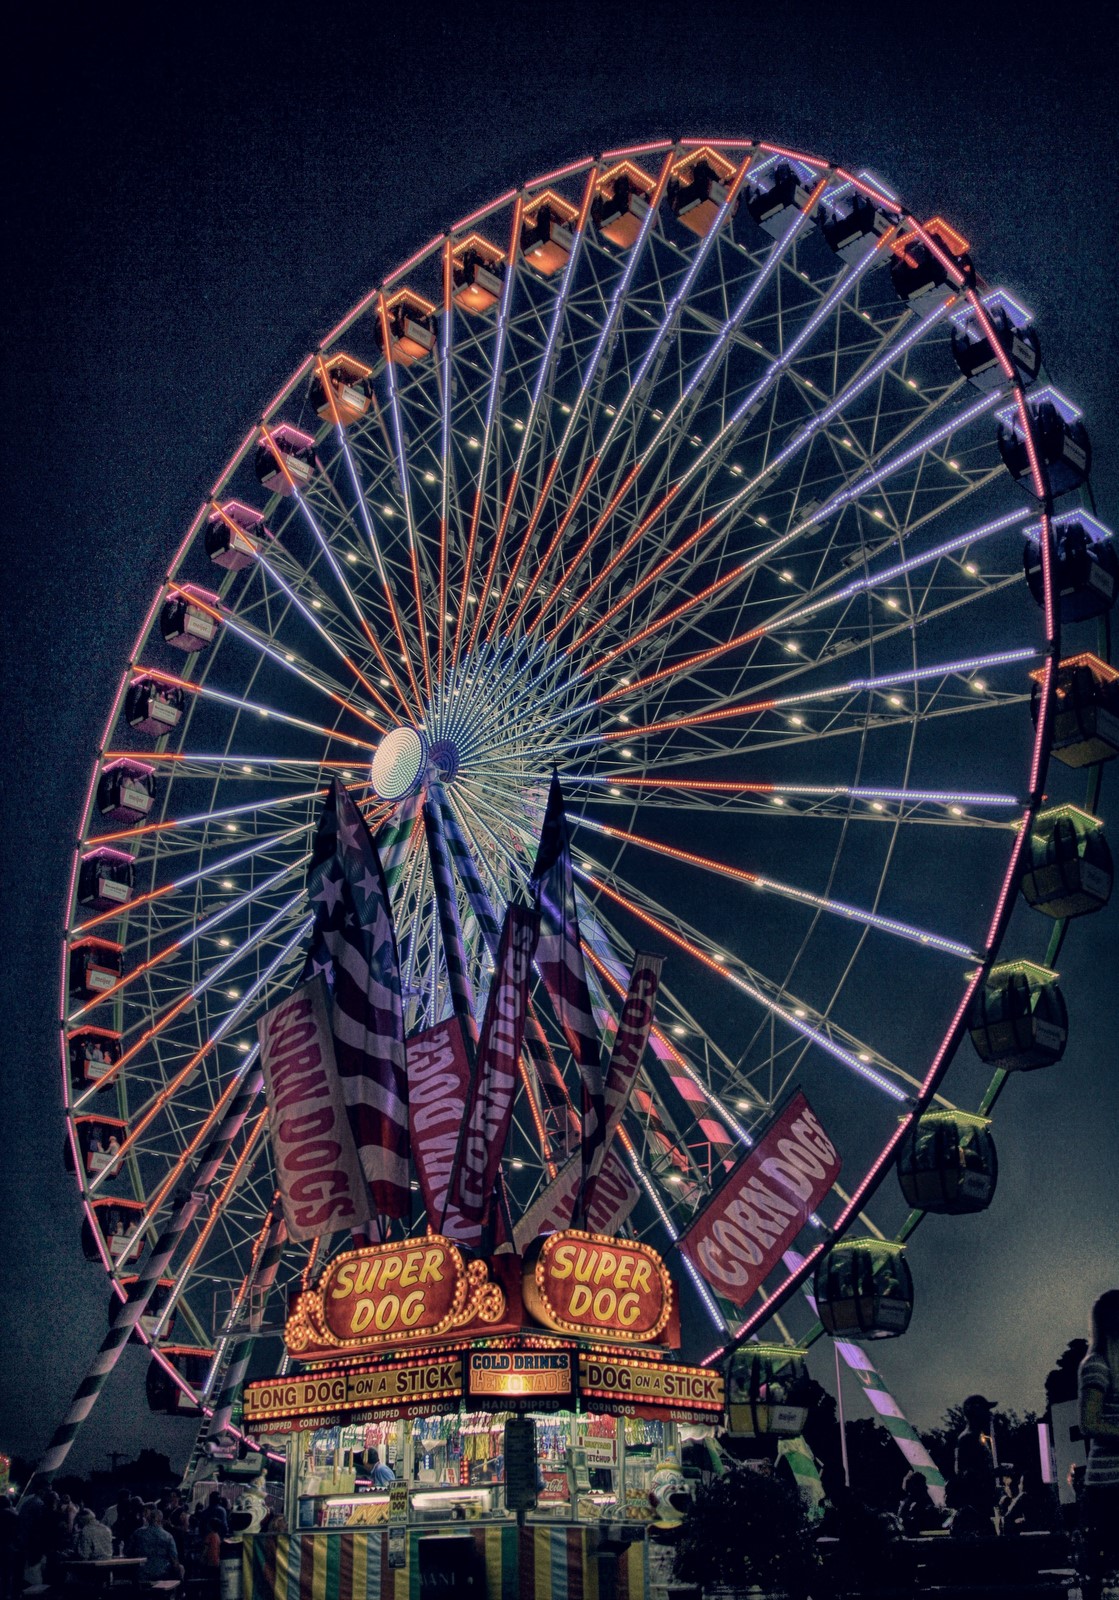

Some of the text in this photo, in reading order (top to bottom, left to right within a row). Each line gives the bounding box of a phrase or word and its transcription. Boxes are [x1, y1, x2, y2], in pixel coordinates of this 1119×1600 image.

[460, 924, 534, 1208] CORN DOGS
[268, 1000, 354, 1227] CORN DOGS
[696, 1107, 836, 1287] CORN DOGS
[331, 1247, 445, 1300] SUPER
[550, 1244, 651, 1294] SUPER
[350, 1291, 426, 1333] DOG
[568, 1284, 641, 1326] DOG
[472, 1355, 568, 1369] COLD DRINKS
[251, 1365, 453, 1410] LONG DOG ON A STICK
[471, 1370, 570, 1392] LEMONADE
[588, 1365, 715, 1399] DOG ON A STICK
[408, 1403, 454, 1416] CORN DOGS
[482, 1400, 559, 1409] HAND DIPPED
[588, 1402, 636, 1415] CORN DOGS
[299, 1416, 340, 1428] CORN DOGS
[351, 1409, 399, 1422] HAND DIPPED
[670, 1410, 719, 1423] HAND DIPPED
[248, 1421, 292, 1433] HAND DIPPED
[390, 1492, 407, 1501] MEGA
[392, 1501, 405, 1511] DOG
